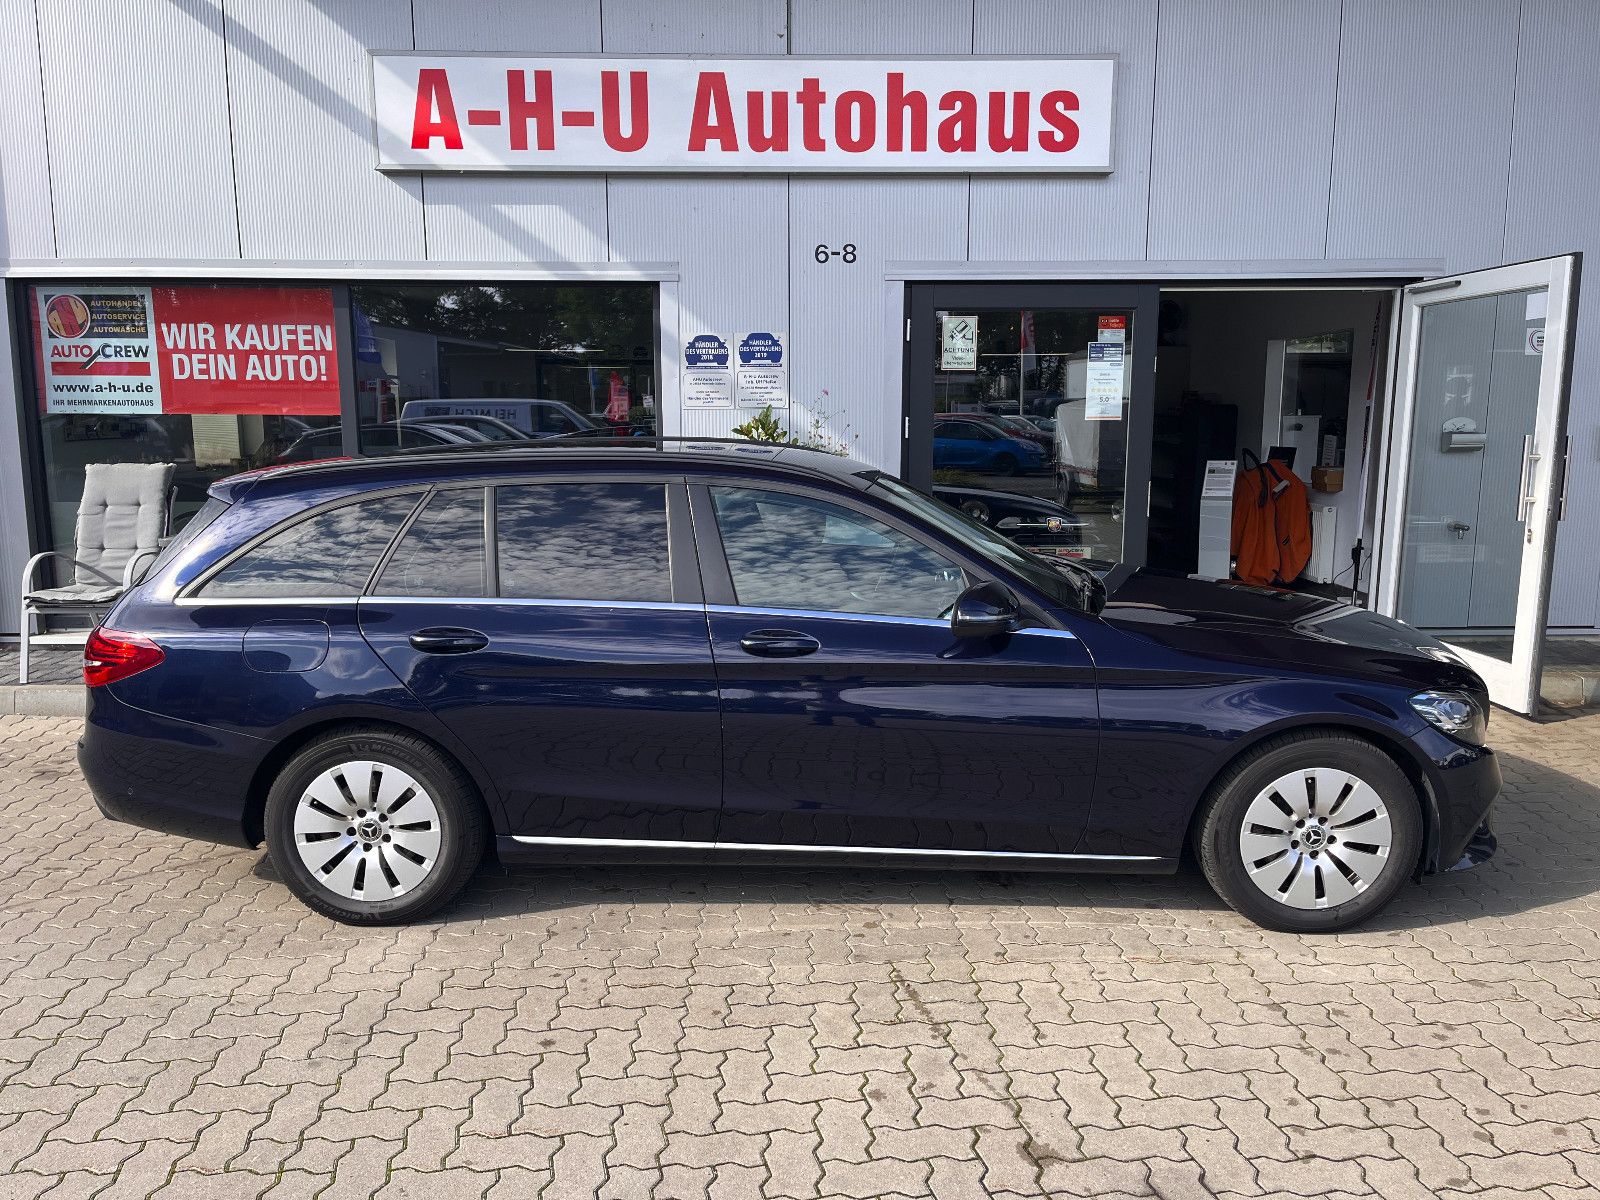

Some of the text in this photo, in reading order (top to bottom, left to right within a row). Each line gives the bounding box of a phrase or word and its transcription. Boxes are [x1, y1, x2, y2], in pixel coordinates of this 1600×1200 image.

[411, 68, 1080, 153] A-H-U Autohaus
[814, 243, 857, 263] 6-8
[93, 325, 146, 333] AUTOWÄSCHE
[161, 323, 333, 351] WIR KAUFEN
[172, 353, 327, 381] DEIN AUTO!
[53, 382, 154, 393] www.a-h-u.de
